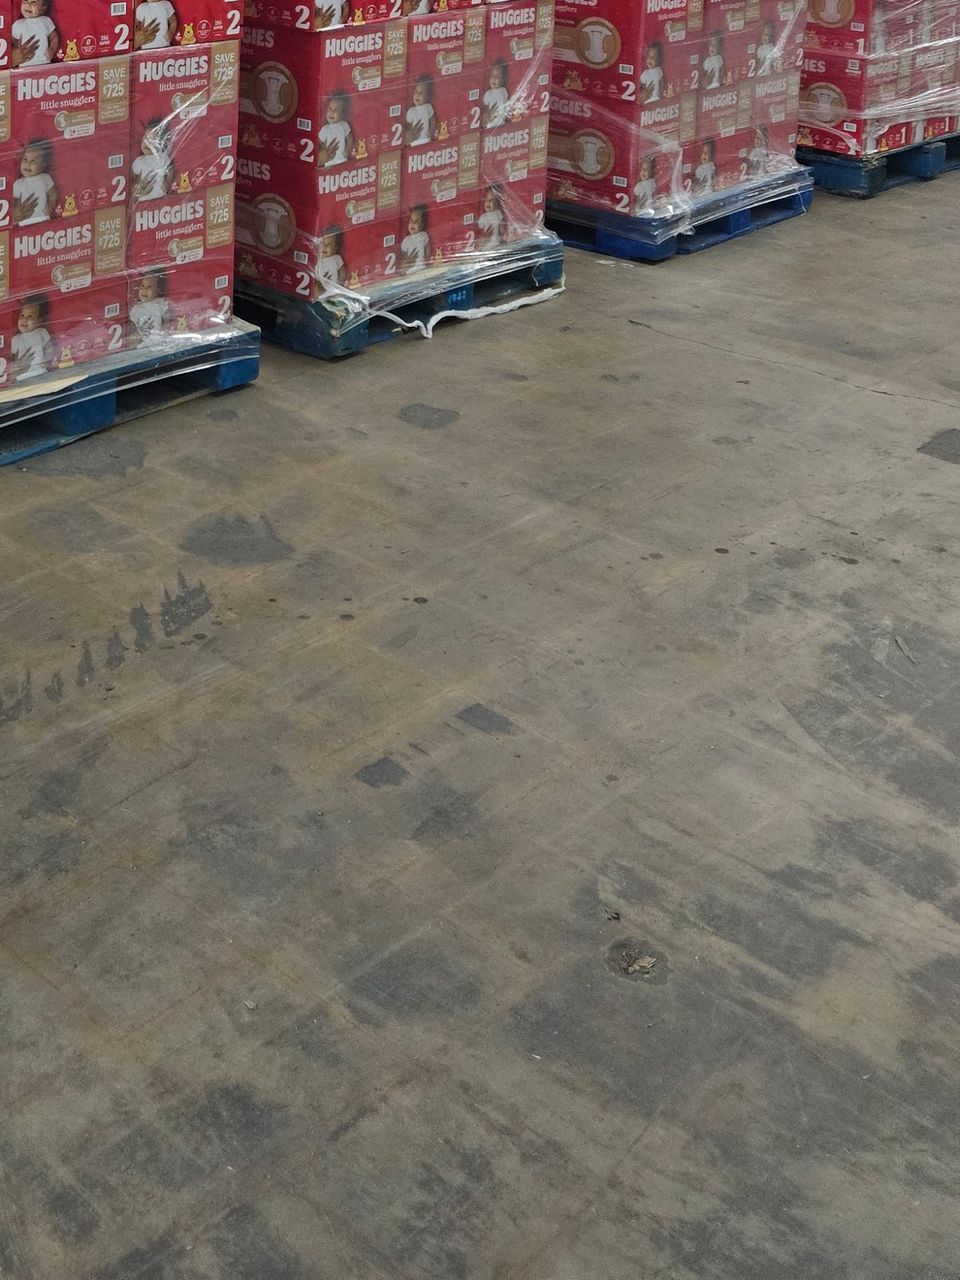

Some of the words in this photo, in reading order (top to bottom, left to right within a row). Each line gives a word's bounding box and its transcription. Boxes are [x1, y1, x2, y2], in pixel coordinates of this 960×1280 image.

[226, 10, 240, 35] 2
[490, 7, 535, 29] HUGGIES
[113, 24, 129, 52] 2
[325, 32, 383, 58] HUGGIES
[856, 38, 865, 55] 1
[139, 55, 209, 83] HUGGIES
[17, 71, 96, 101] HUGGIES
[408, 147, 458, 173] HUGGIES
[135, 199, 204, 232] HUGGIES
[615, 192, 630, 213] 2
[14, 223, 92, 259] HUGGIES
[155, 228, 171, 240] little
[171, 222, 204, 237] snugglers
[296, 272, 310, 296] 2
